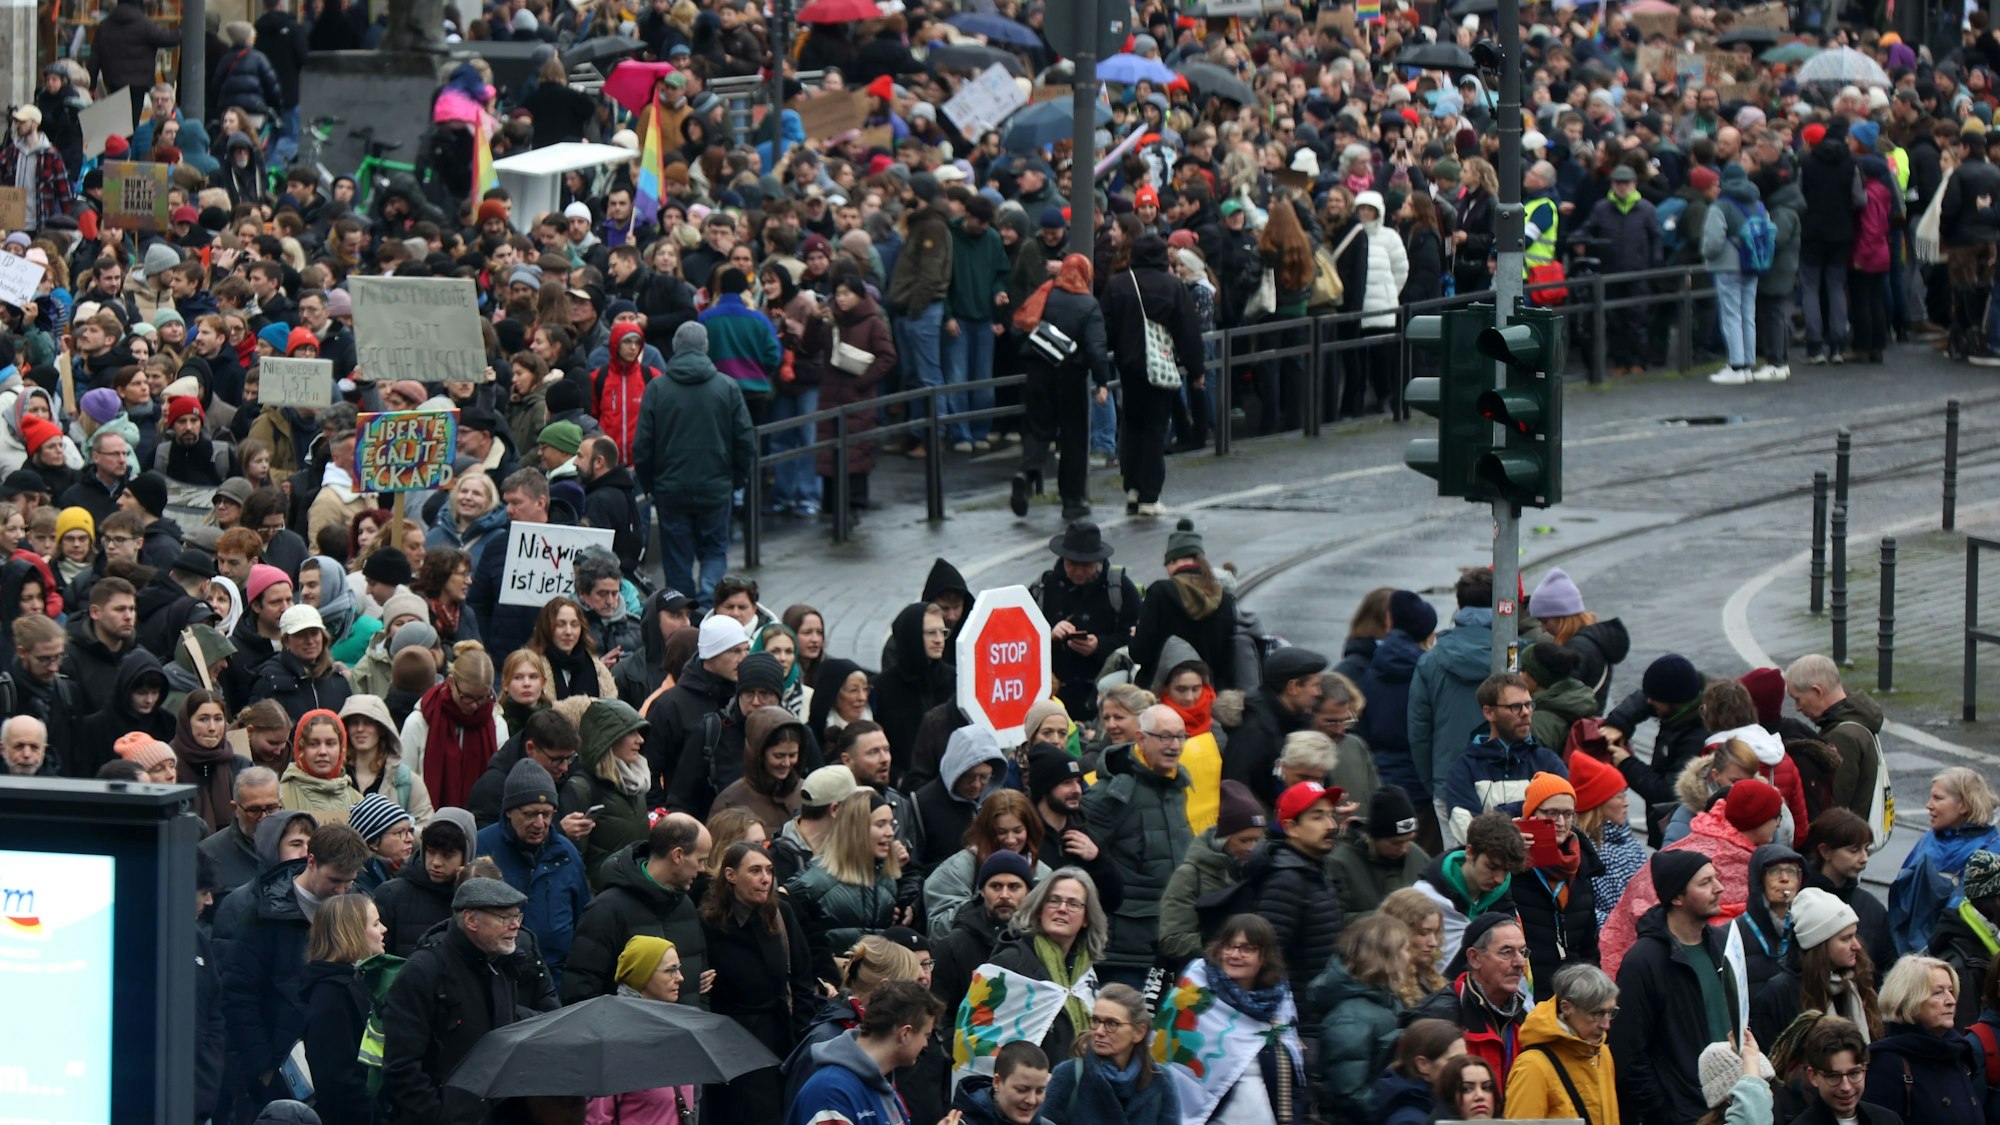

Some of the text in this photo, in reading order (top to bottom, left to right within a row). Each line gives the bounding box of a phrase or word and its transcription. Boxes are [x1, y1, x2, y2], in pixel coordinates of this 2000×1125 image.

[124, 178, 147, 189] BUNT
[124, 190, 152, 200] STATT
[124, 200, 153, 211] BRAUN
[392, 320, 441, 341] STATT
[263, 361, 320, 376] NIE WIEDER
[282, 376, 311, 392] IST
[518, 532, 583, 561] Nie wie
[511, 569, 574, 594] ist jetz
[990, 641, 1027, 665] STOP
[991, 678, 1023, 703] AFD
